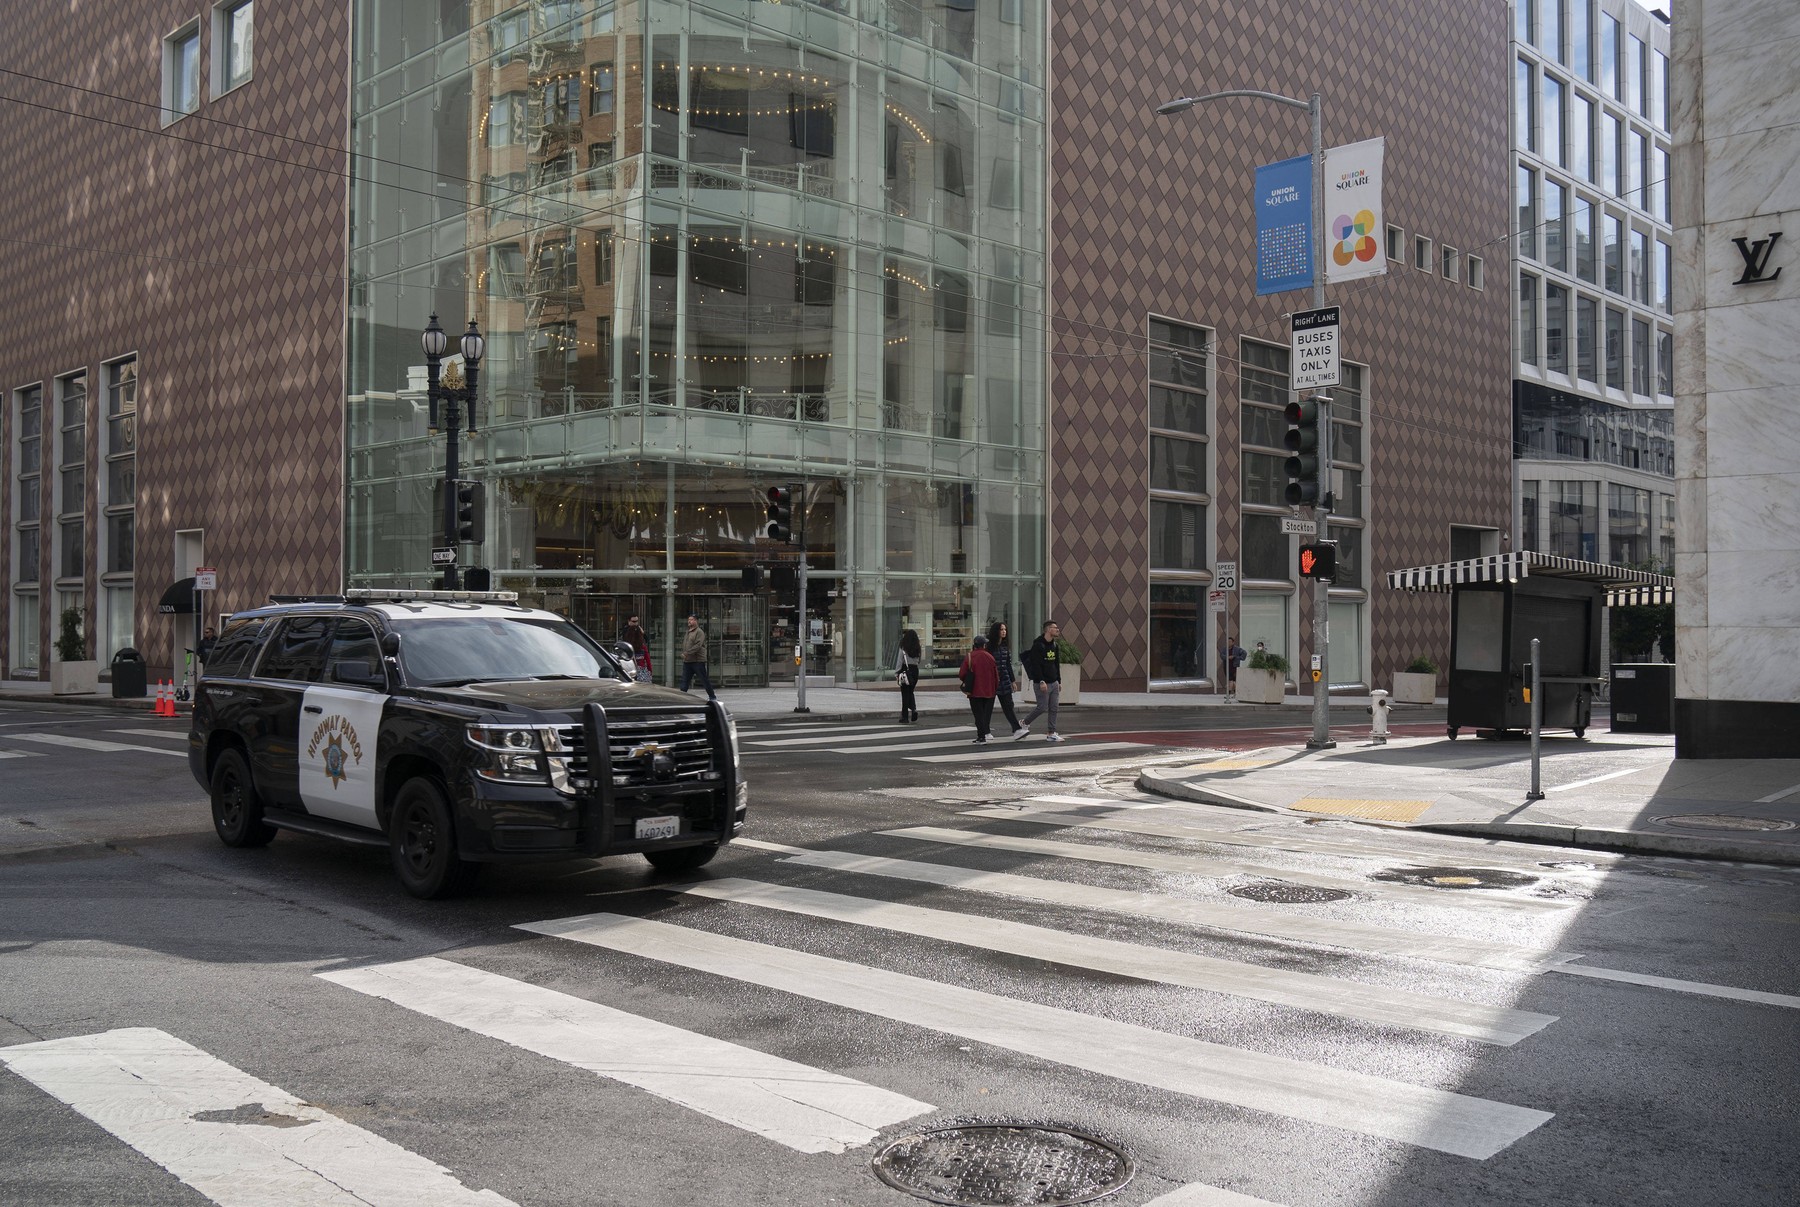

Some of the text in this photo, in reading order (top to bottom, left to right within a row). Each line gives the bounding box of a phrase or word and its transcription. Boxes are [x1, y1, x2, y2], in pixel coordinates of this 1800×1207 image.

[1341, 169, 1365, 181] UNION
[1335, 175, 1370, 191] SQUARE
[1271, 186, 1295, 196] UNION
[1265, 192, 1301, 207] SQUARE
[1295, 313, 1336, 327] RIGHT LANE
[1297, 331, 1333, 345] BUSES
[1300, 345, 1331, 358] TAXIS
[1300, 359, 1330, 372] ONLY
[1296, 372, 1336, 384] AT ALL TIMES
[1286, 521, 1314, 532] Stockton
[1218, 576, 1235, 588] 20
[308, 715, 363, 765] HIGHWAY PATROL
